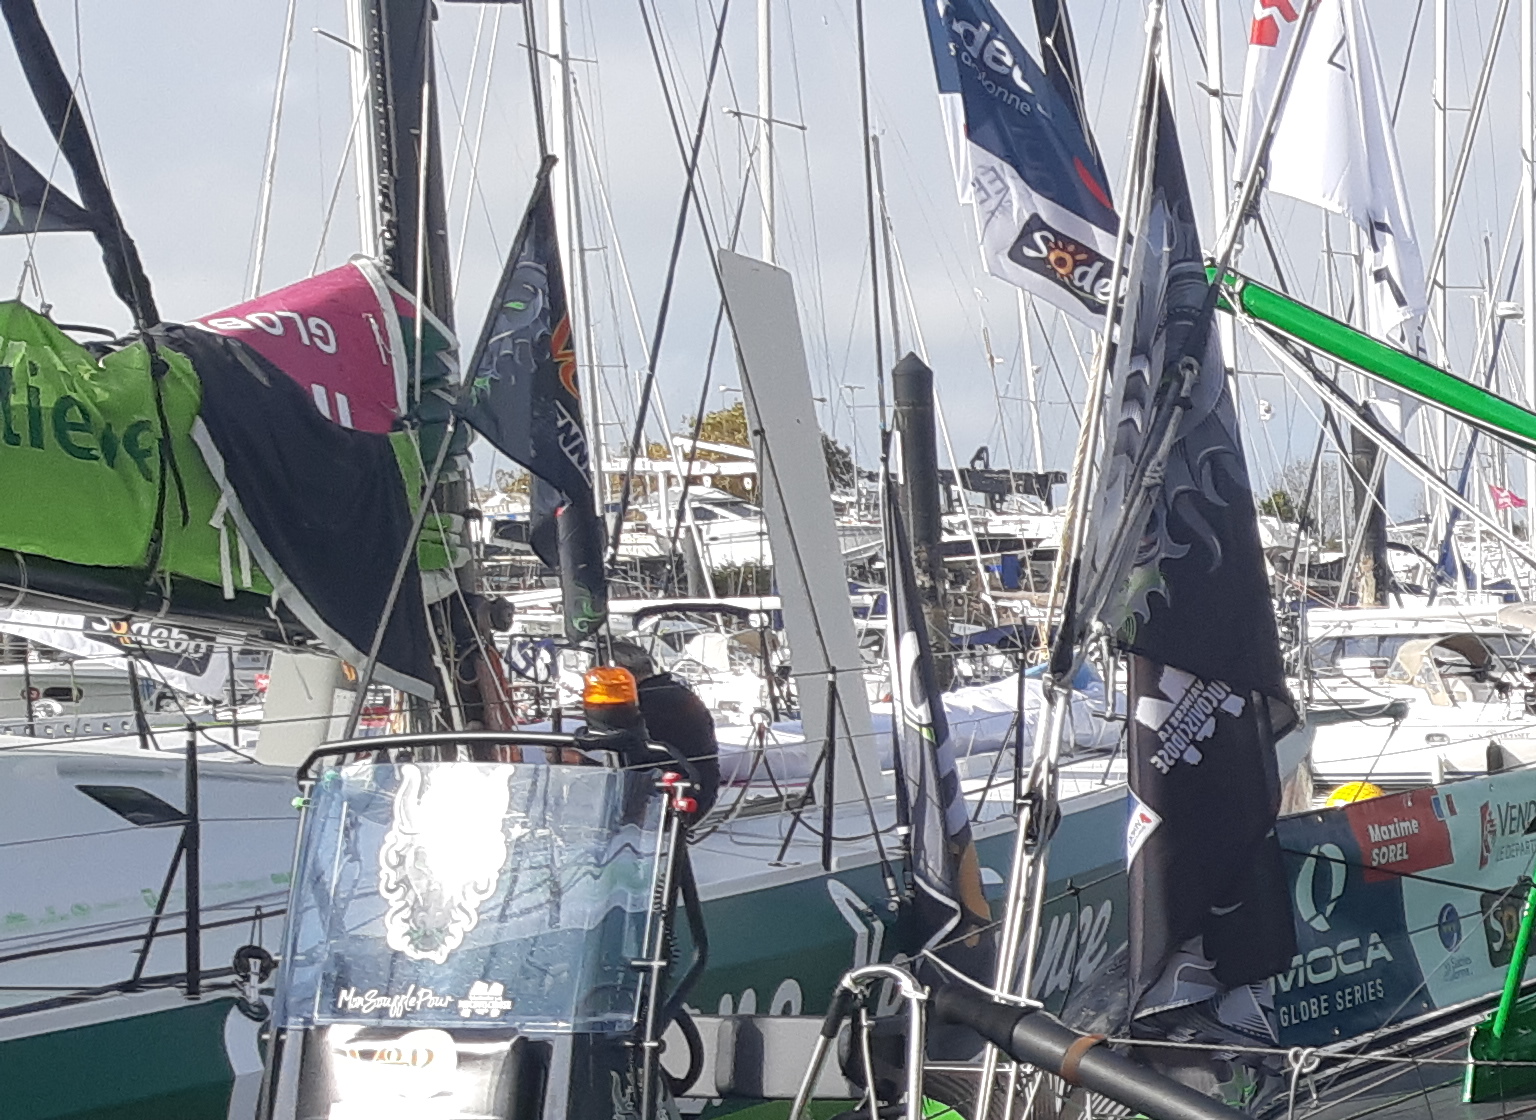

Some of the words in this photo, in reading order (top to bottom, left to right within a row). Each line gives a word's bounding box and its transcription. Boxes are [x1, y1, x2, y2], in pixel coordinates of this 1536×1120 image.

[1367, 817, 1420, 842] Maxime
[1370, 848, 1410, 867] SOREL
[1279, 994, 1330, 1027] GLOBE
[1335, 979, 1385, 1013] SERIES
